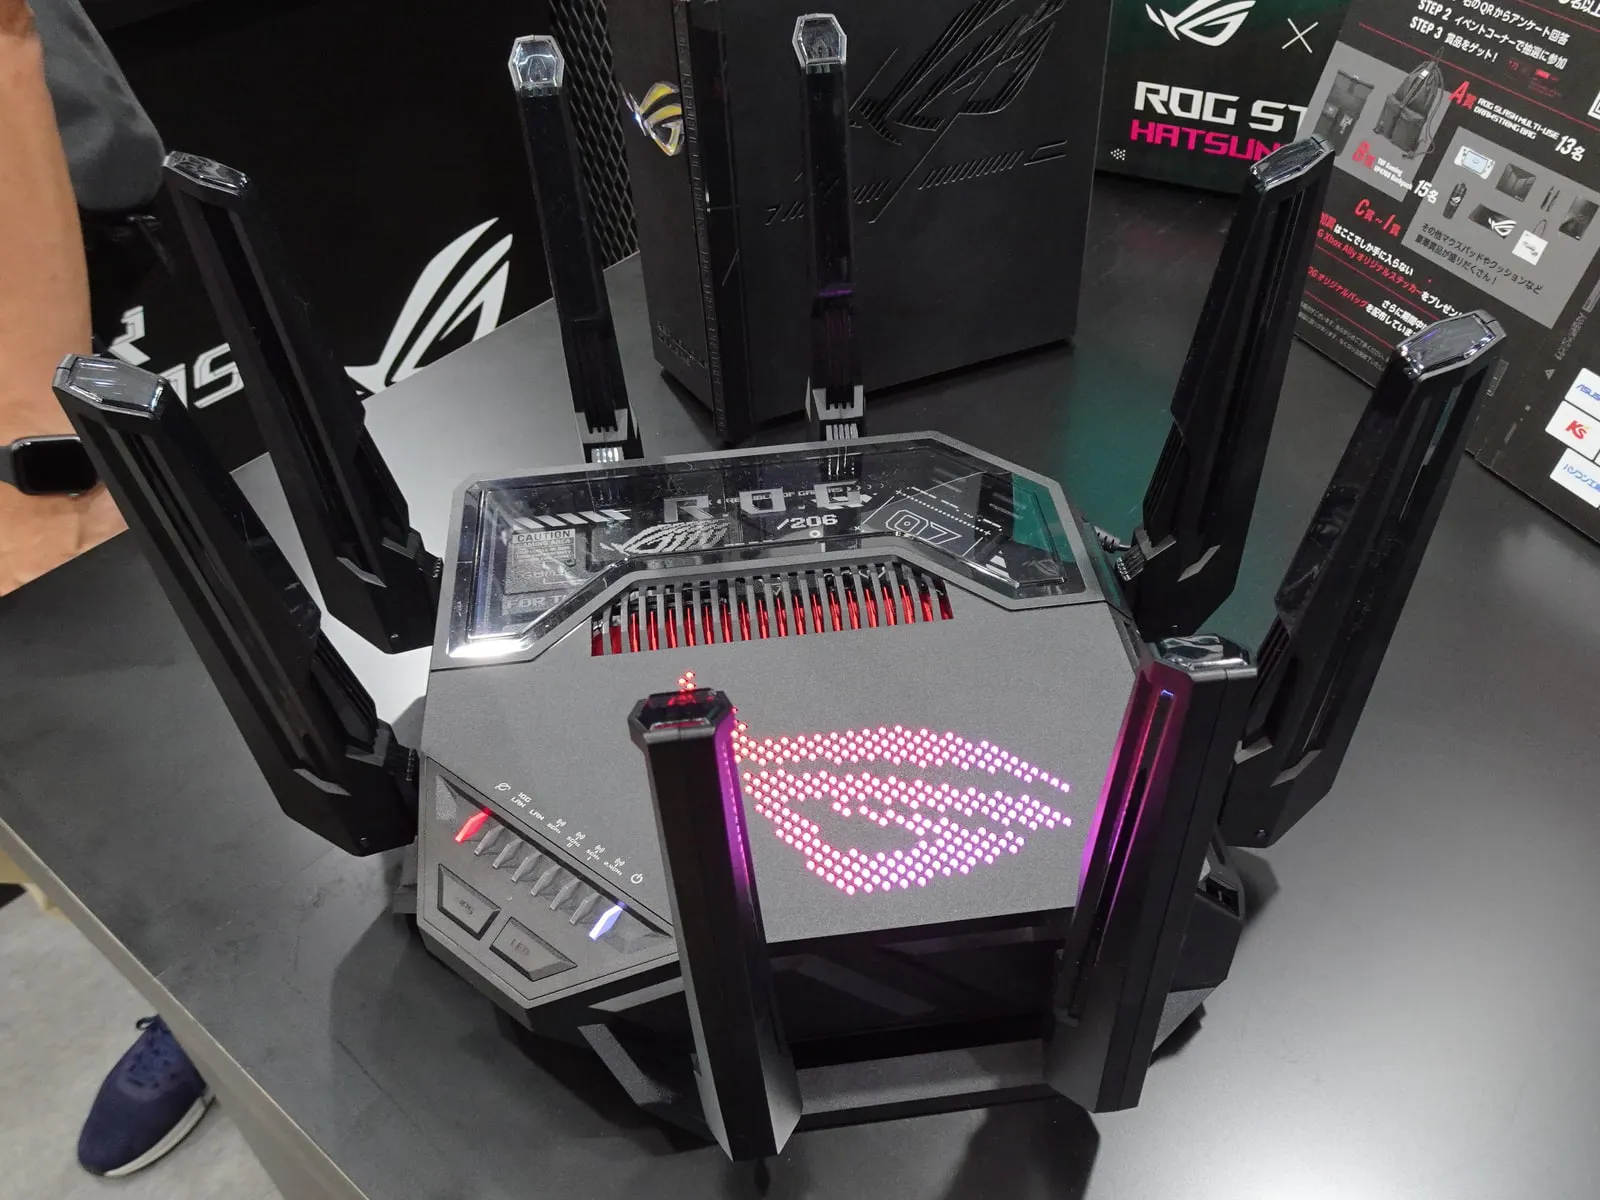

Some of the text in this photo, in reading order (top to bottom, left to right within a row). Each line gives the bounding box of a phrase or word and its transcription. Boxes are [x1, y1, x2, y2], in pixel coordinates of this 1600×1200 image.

[1418, 0, 1443, 16] STEP
[1442, 7, 1452, 20] 2
[1558, 0, 1600, 17] 名以上
[1410, 16, 1435, 34] STEP
[1433, 26, 1443, 39] 3
[1134, 81, 1240, 125] ROG
[1477, 97, 1493, 111] ROG
[1494, 104, 1519, 122] SLASH
[1130, 119, 1286, 161] HATSUN
[1519, 127, 1538, 140] BAG
[1555, 135, 1586, 162] 13名
[1413, 180, 1439, 204] 15名
[517, 530, 570, 542] CAUTION
[511, 796, 527, 808] LAN
[529, 809, 545, 821] LAN
